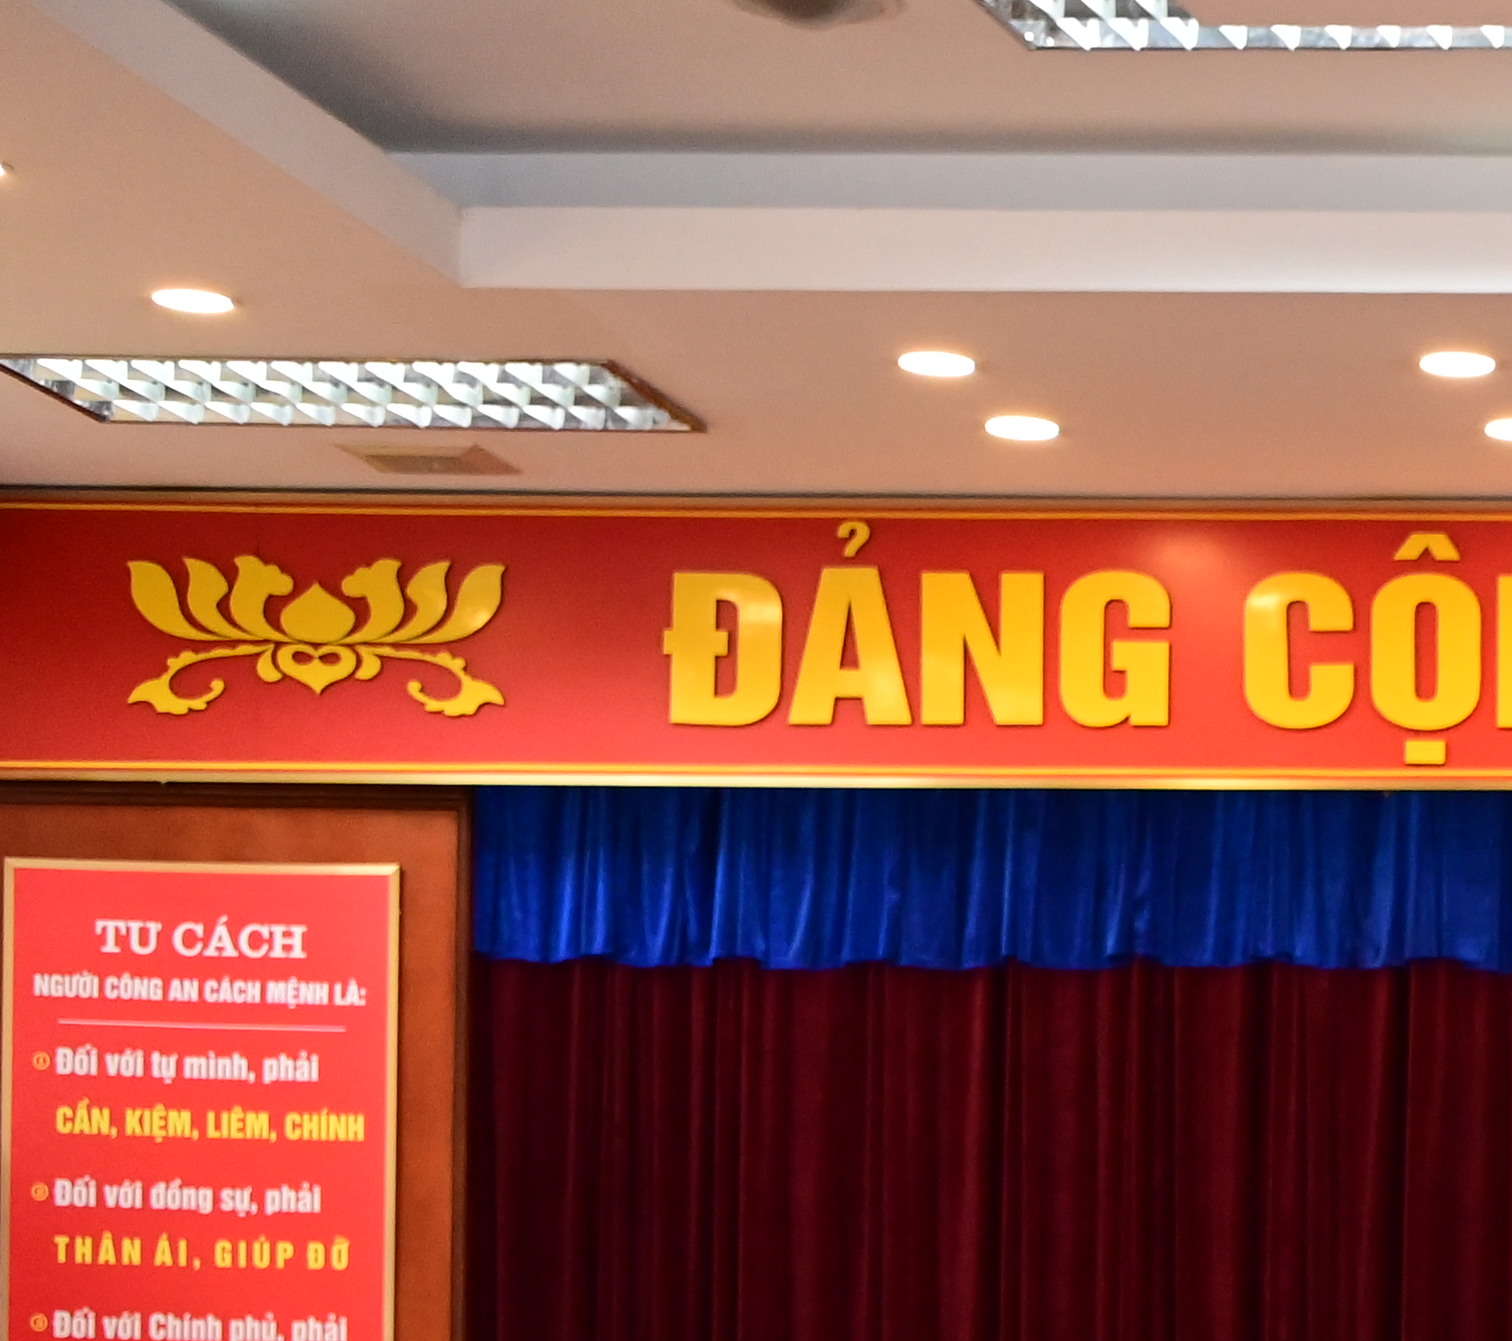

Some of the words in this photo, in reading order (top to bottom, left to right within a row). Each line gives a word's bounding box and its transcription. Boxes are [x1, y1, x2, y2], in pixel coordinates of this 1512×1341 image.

[663, 520, 1173, 728] ĐẢNG
[172, 915, 308, 959] CÁCH
[33, 970, 100, 999] NGƯỜI
[104, 972, 164, 1001] CÔNG
[168, 978, 200, 1002] AN
[203, 975, 262, 1004] CÁCH
[265, 976, 330, 1009] MỆNH
[333, 978, 367, 1007] LÀ:
[55, 1044, 98, 1076] Đối
[105, 1048, 145, 1078] với
[151, 1050, 179, 1084] tự
[262, 1050, 320, 1085] phải
[125, 1103, 200, 1143] KIỆM,
[206, 1105, 277, 1143] LIÊM,
[284, 1108, 365, 1142] CHÍNH
[54, 1175, 97, 1208] Đối
[103, 1180, 143, 1209] với
[220, 1186, 259, 1218] sự,
[264, 1181, 322, 1216] phải
[54, 1231, 142, 1266] THÂN
[154, 1233, 201, 1271] ÁI,
[214, 1235, 295, 1269] GIÚP
[306, 1235, 350, 1271] ĐỠ
[53, 1307, 96, 1339] Đối
[102, 1311, 142, 1340] với
[148, 1312, 223, 1341] Chính
